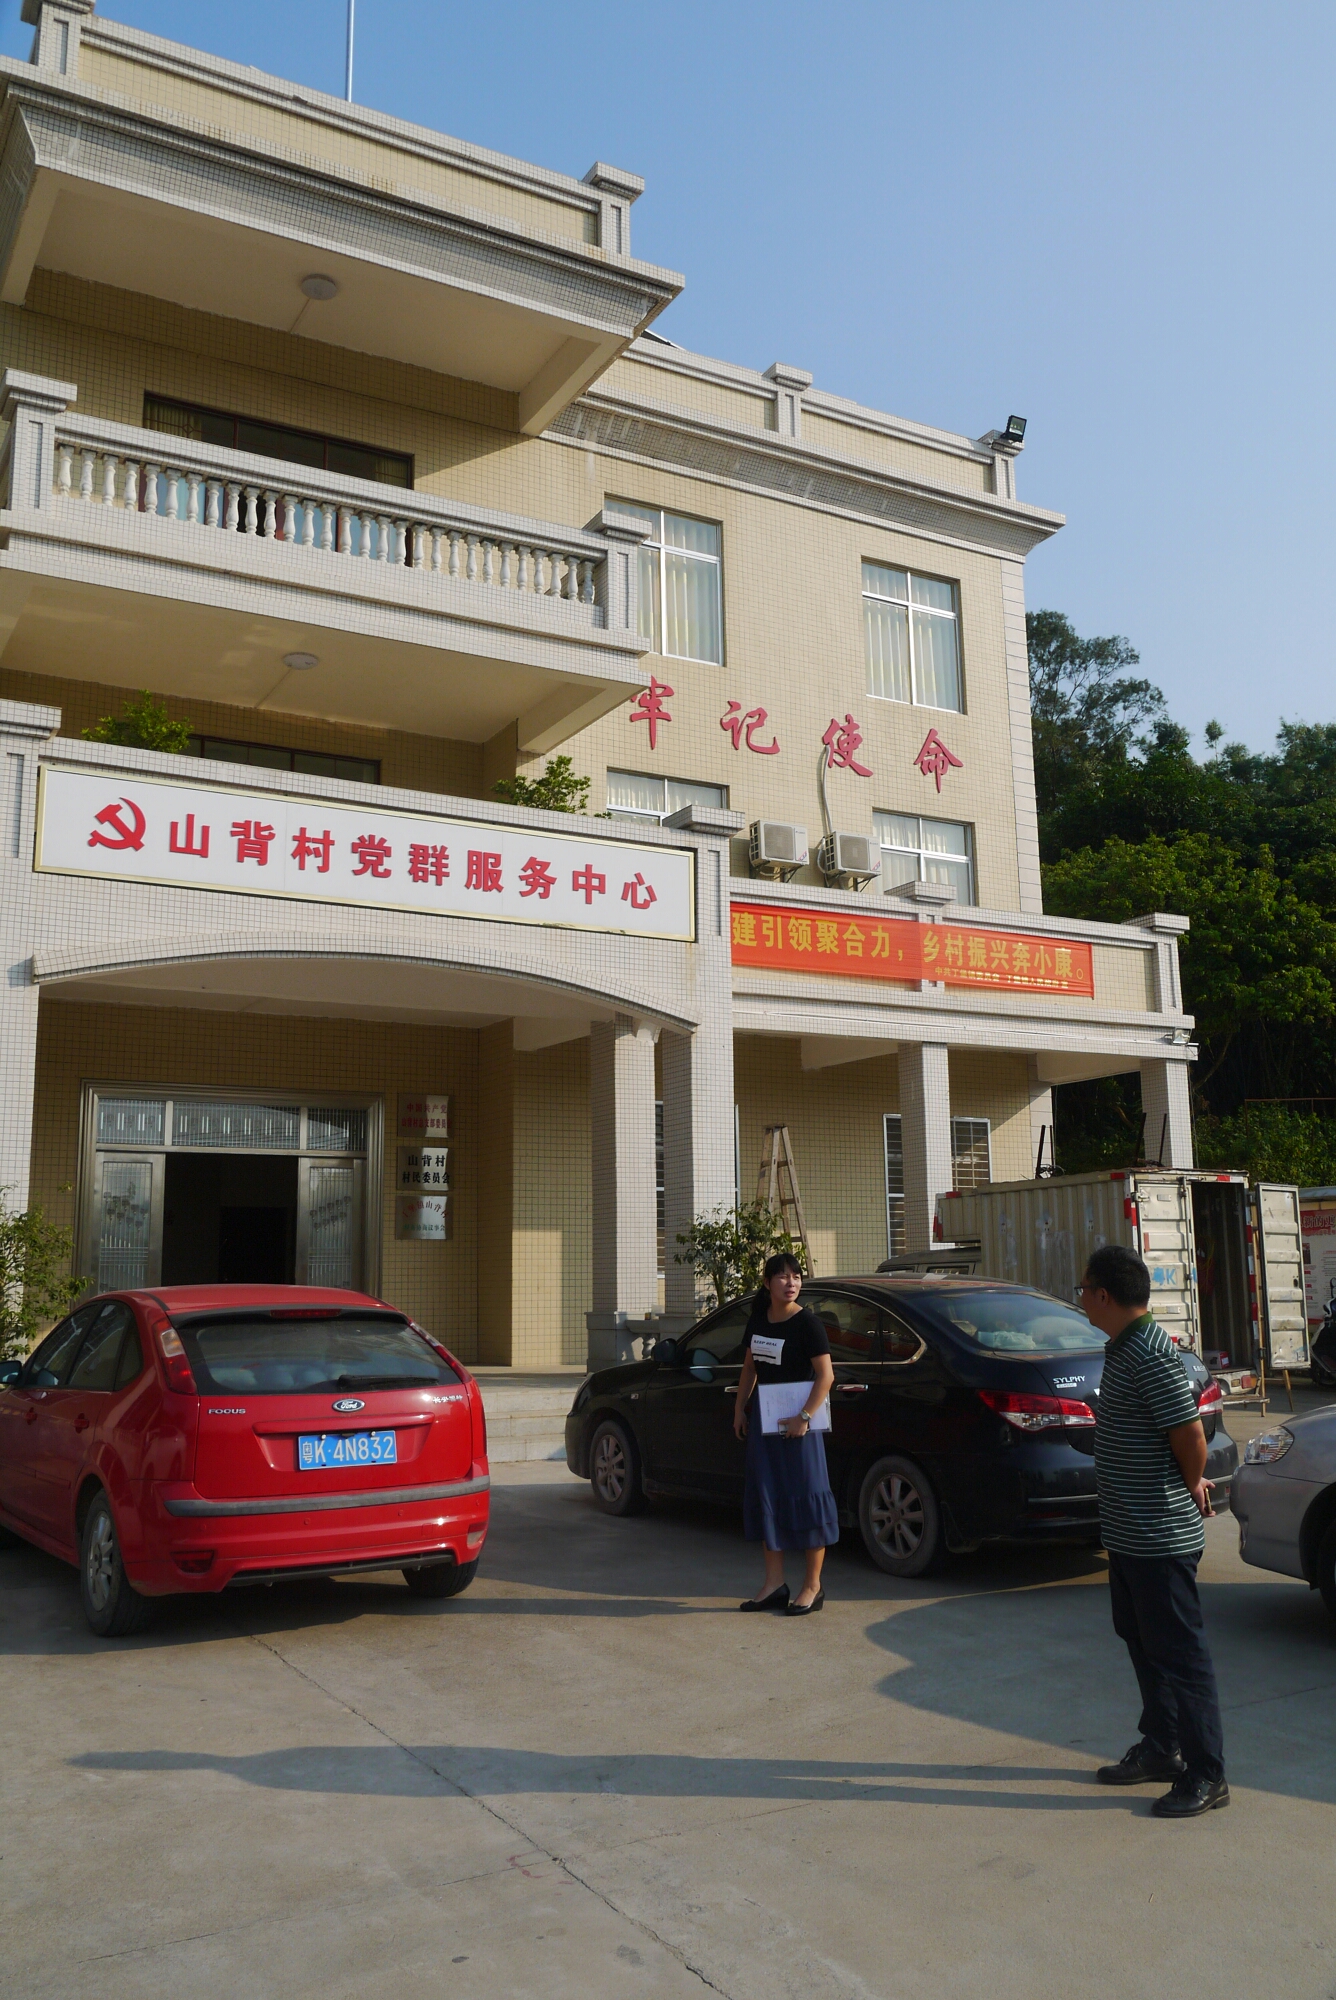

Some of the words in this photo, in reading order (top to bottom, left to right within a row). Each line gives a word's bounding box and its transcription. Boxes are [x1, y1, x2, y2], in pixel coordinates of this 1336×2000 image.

[630, 676, 964, 793] 牢记使命
[169, 813, 658, 910] 山背村党群服务中心
[406, 1103, 447, 1114] 中国共产党
[408, 1154, 446, 1167] 山背村
[402, 1171, 450, 1184] 村民委员会
[1052, 1375, 1086, 1384] SYLPHY
[338, 1399, 360, 1411] Ford
